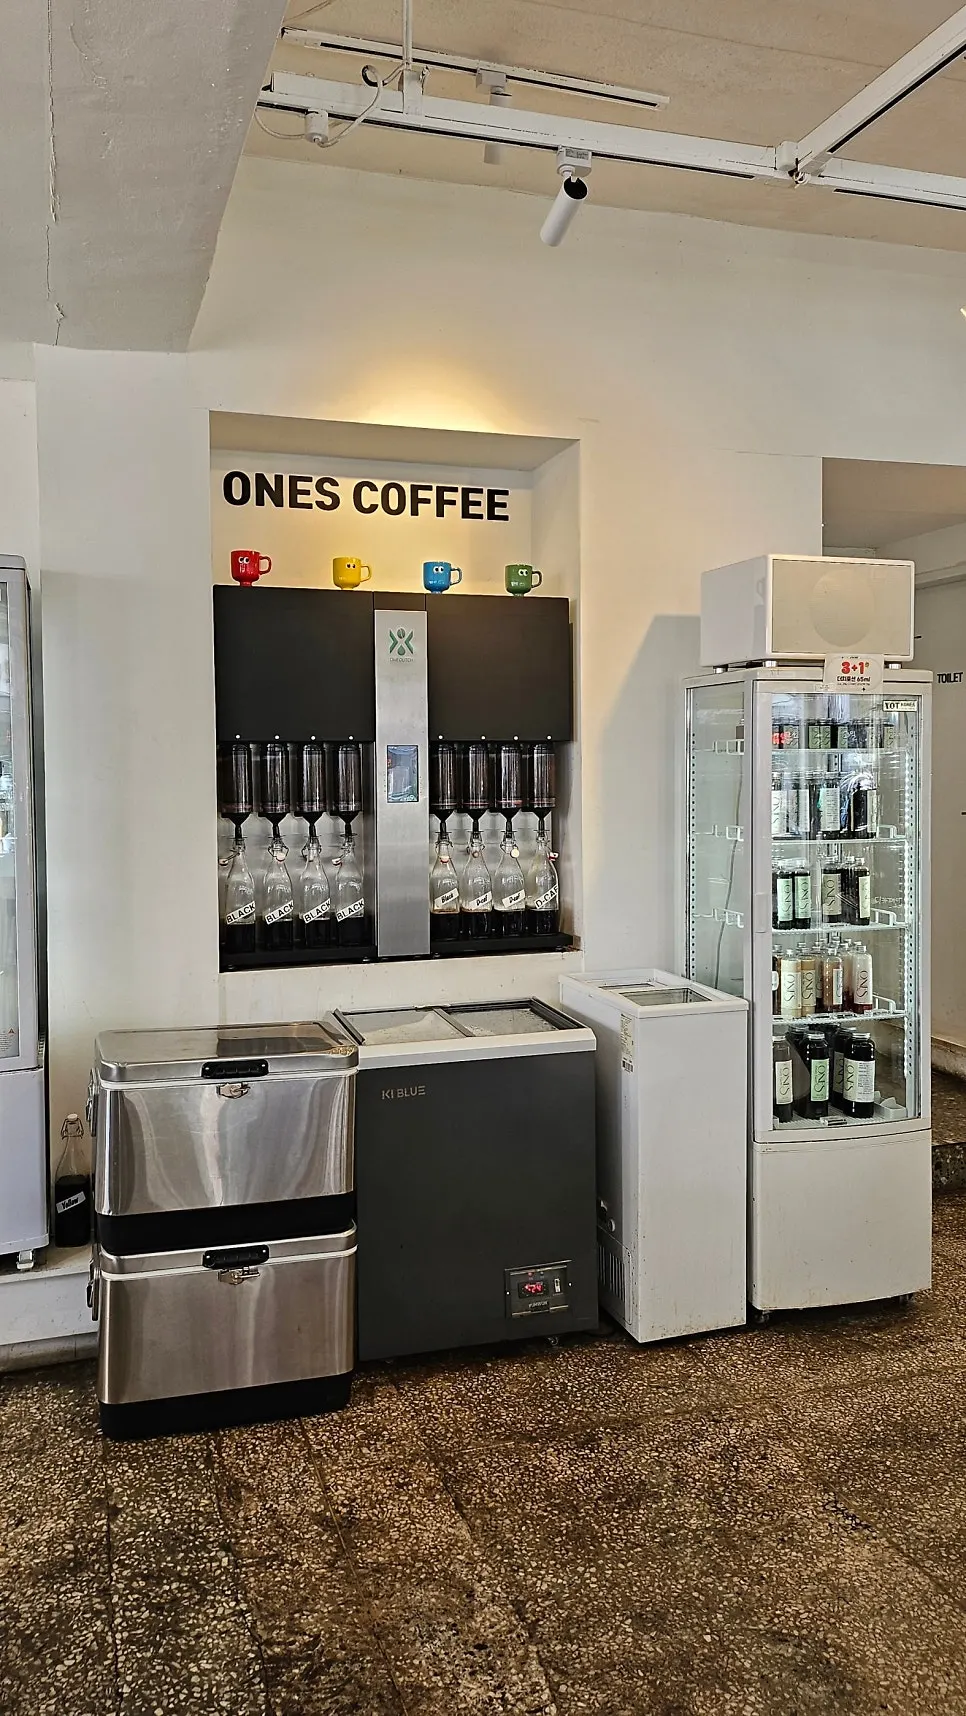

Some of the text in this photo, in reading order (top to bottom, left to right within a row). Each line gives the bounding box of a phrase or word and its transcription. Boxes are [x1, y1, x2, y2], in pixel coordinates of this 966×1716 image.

[223, 470, 510, 522] ONES COFFEE
[936, 671, 964, 684] TOILET
[441, 893, 454, 904] Black
[226, 902, 255, 923] BLACK
[266, 900, 294, 923] BLACK
[304, 899, 331, 922] BLACK
[337, 899, 364, 921] BLACK
[397, 1085, 426, 1098] BLUE
[61, 1196, 79, 1210] Yellow
